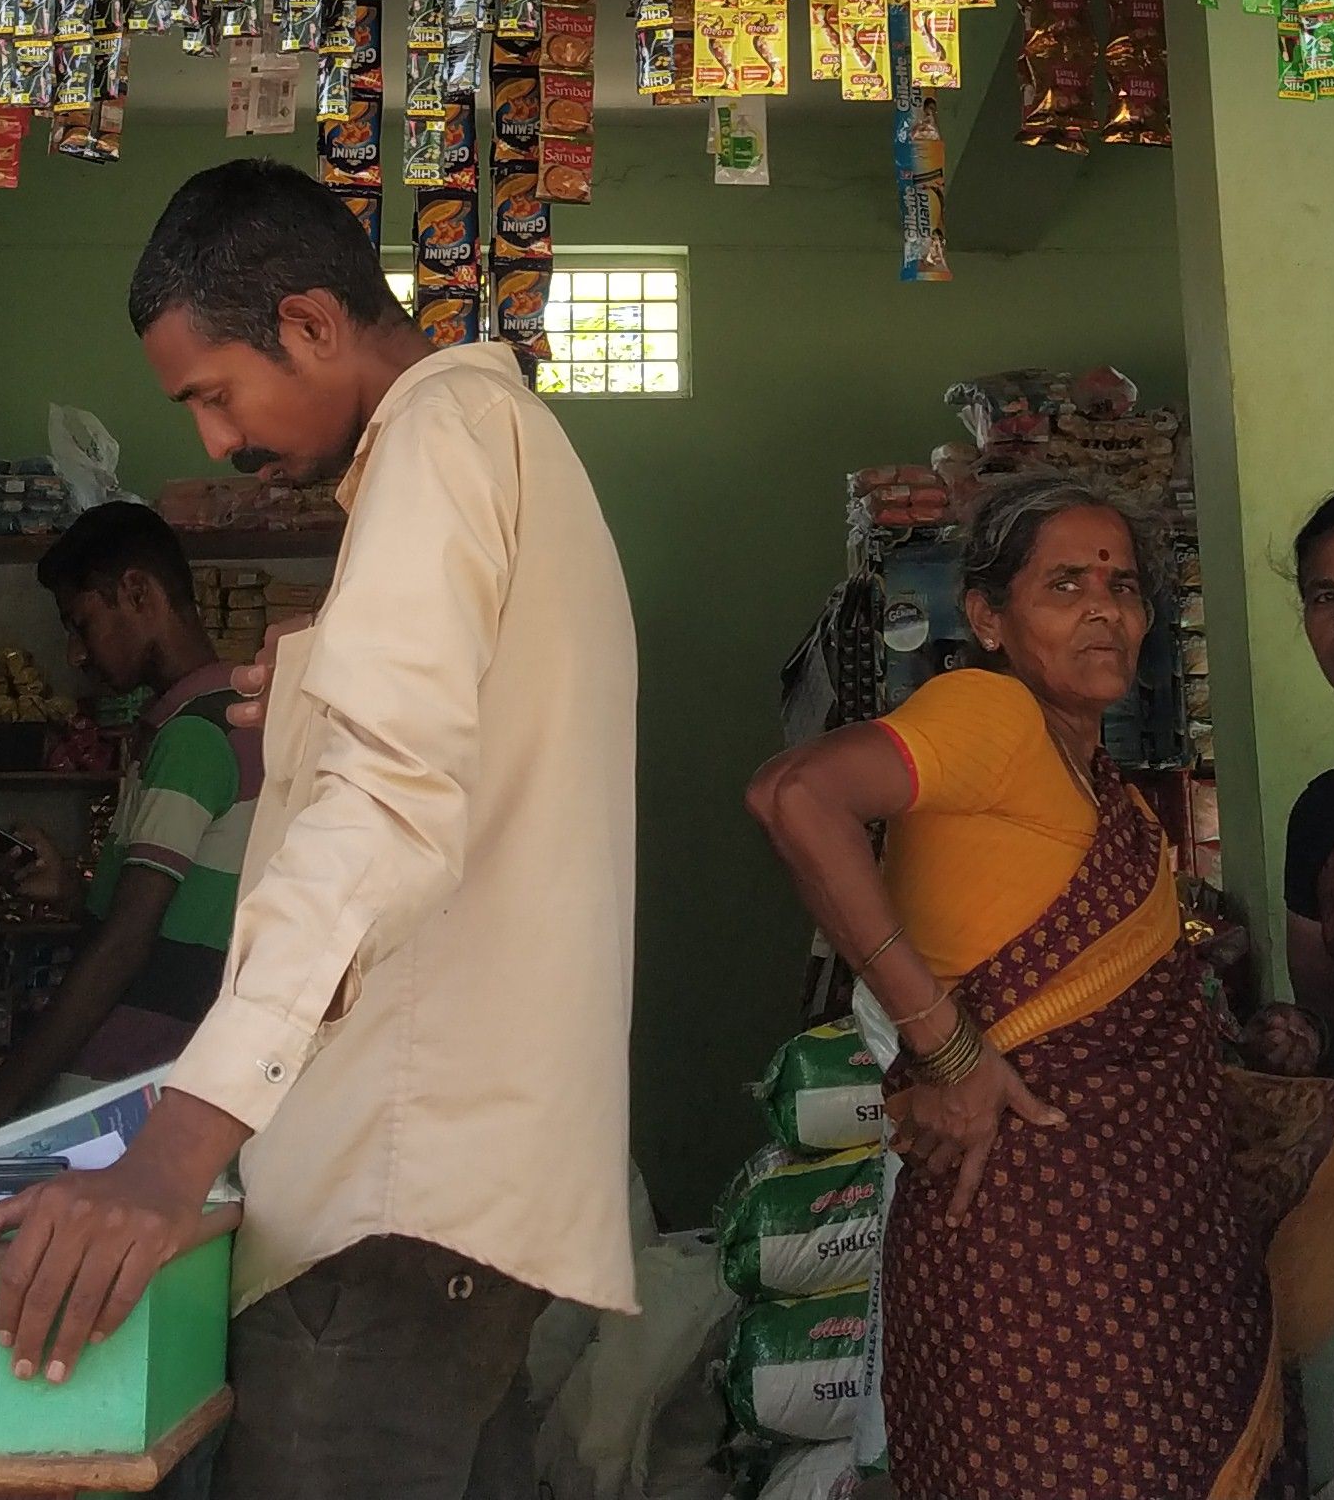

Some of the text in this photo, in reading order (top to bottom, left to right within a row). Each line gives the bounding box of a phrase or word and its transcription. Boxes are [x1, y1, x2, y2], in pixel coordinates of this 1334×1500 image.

[546, 15, 595, 34] Sambar
[17, 45, 48, 60] CHIK
[545, 80, 593, 99] Sambar
[544, 146, 592, 166] Sambar
[406, 167, 440, 181] CHIK
